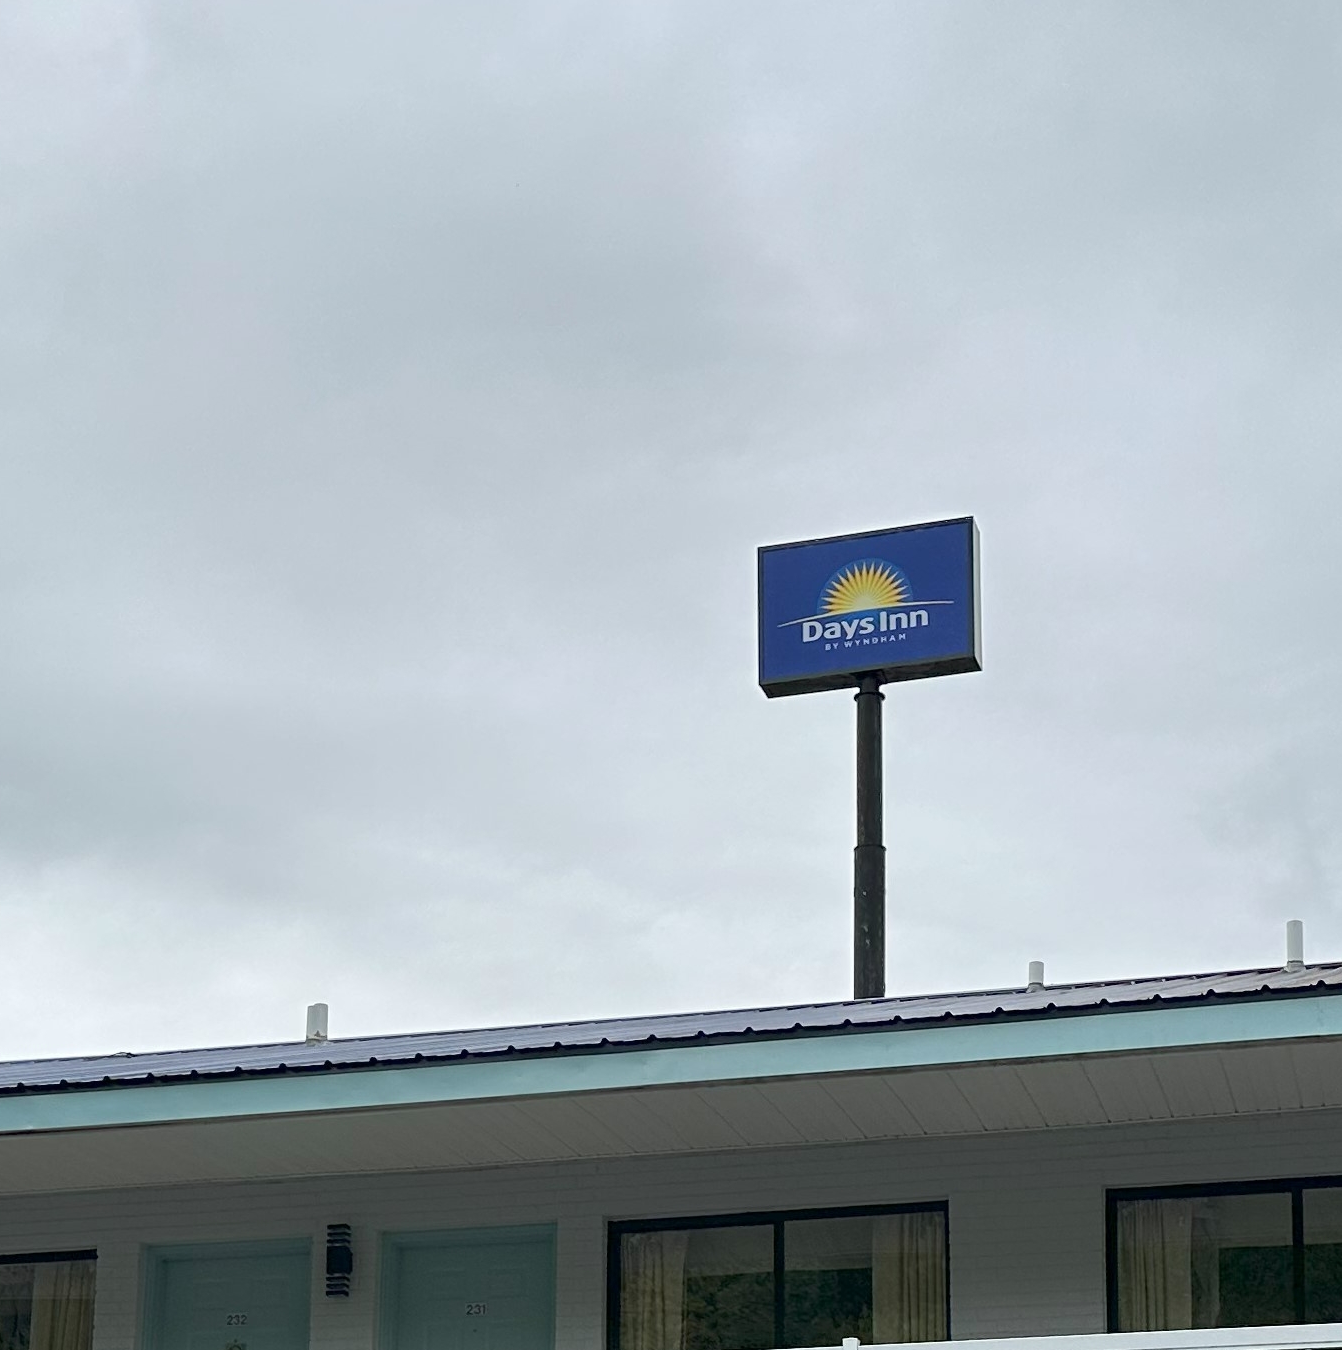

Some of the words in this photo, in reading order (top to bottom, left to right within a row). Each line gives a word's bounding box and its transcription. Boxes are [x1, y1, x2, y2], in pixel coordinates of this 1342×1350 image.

[802, 617, 875, 642] Days
[880, 609, 929, 631] Inn
[825, 643, 839, 651] BY
[844, 633, 906, 648] WYNDHAM
[466, 1303, 486, 1315] 231
[227, 1314, 247, 1326] 232
